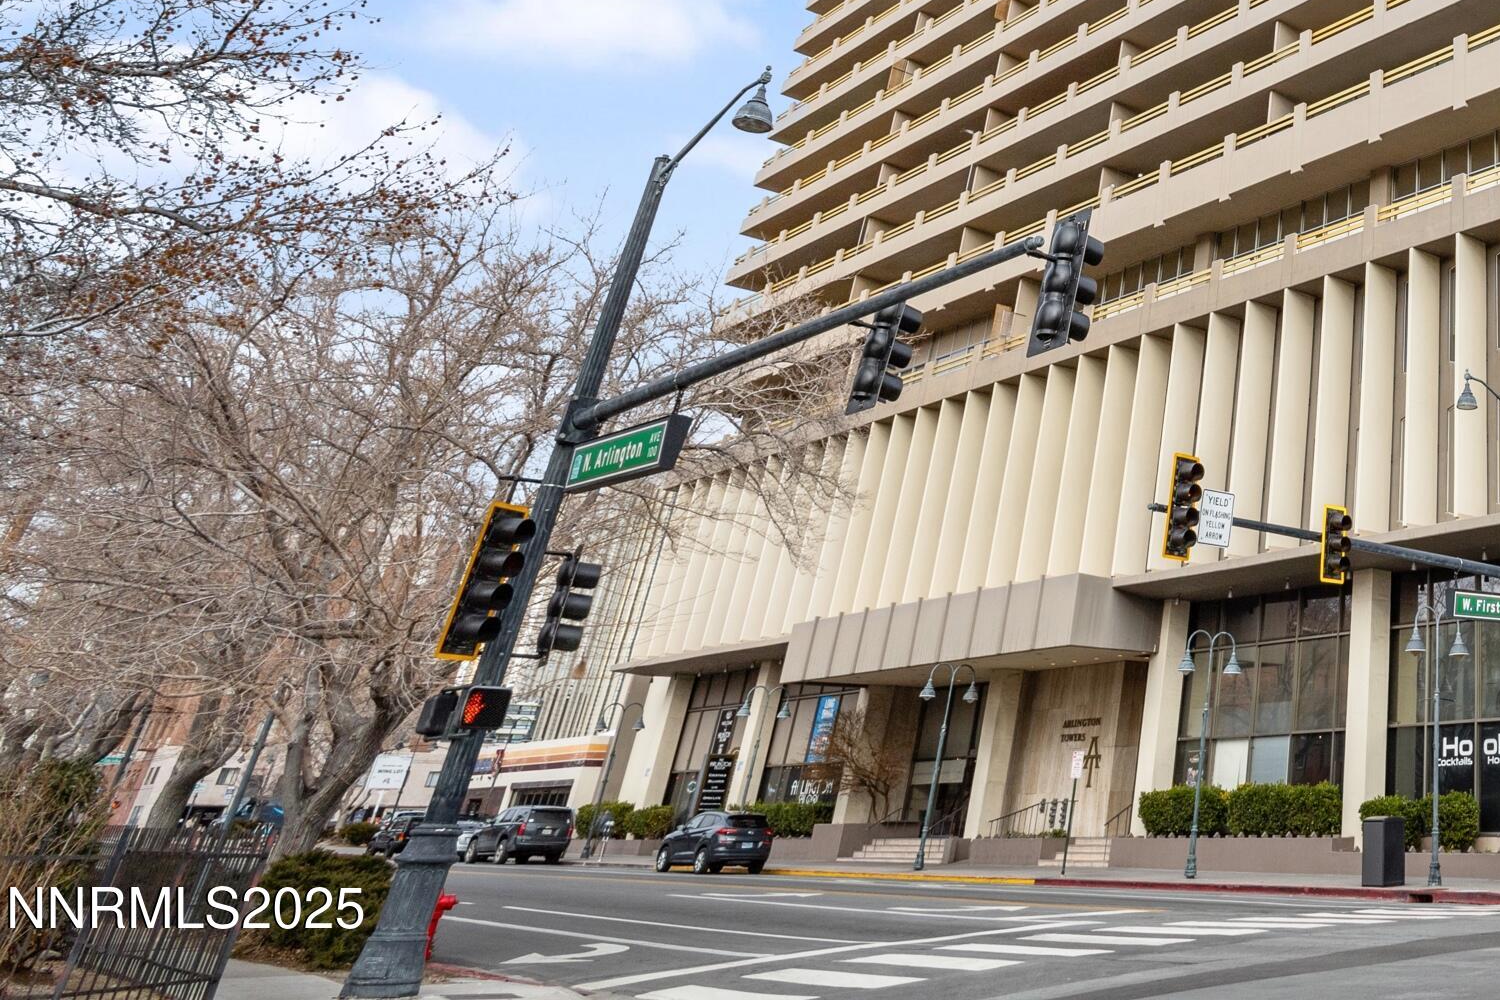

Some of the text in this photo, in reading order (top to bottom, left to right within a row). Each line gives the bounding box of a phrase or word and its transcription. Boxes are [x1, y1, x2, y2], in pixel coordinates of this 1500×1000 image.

[649, 430, 662, 444] AVE
[582, 441, 643, 473] N. Arlington
[647, 446, 658, 459] 100
[1208, 496, 1229, 507] YIELD
[1202, 508, 1231, 520] ON FLASHING
[1206, 520, 1225, 529] YELLOW
[1205, 531, 1222, 540] ARROW
[1462, 598, 1500, 614] W. First
[1062, 717, 1102, 728] ARLINGTON
[1061, 733, 1086, 743] TOWERS
